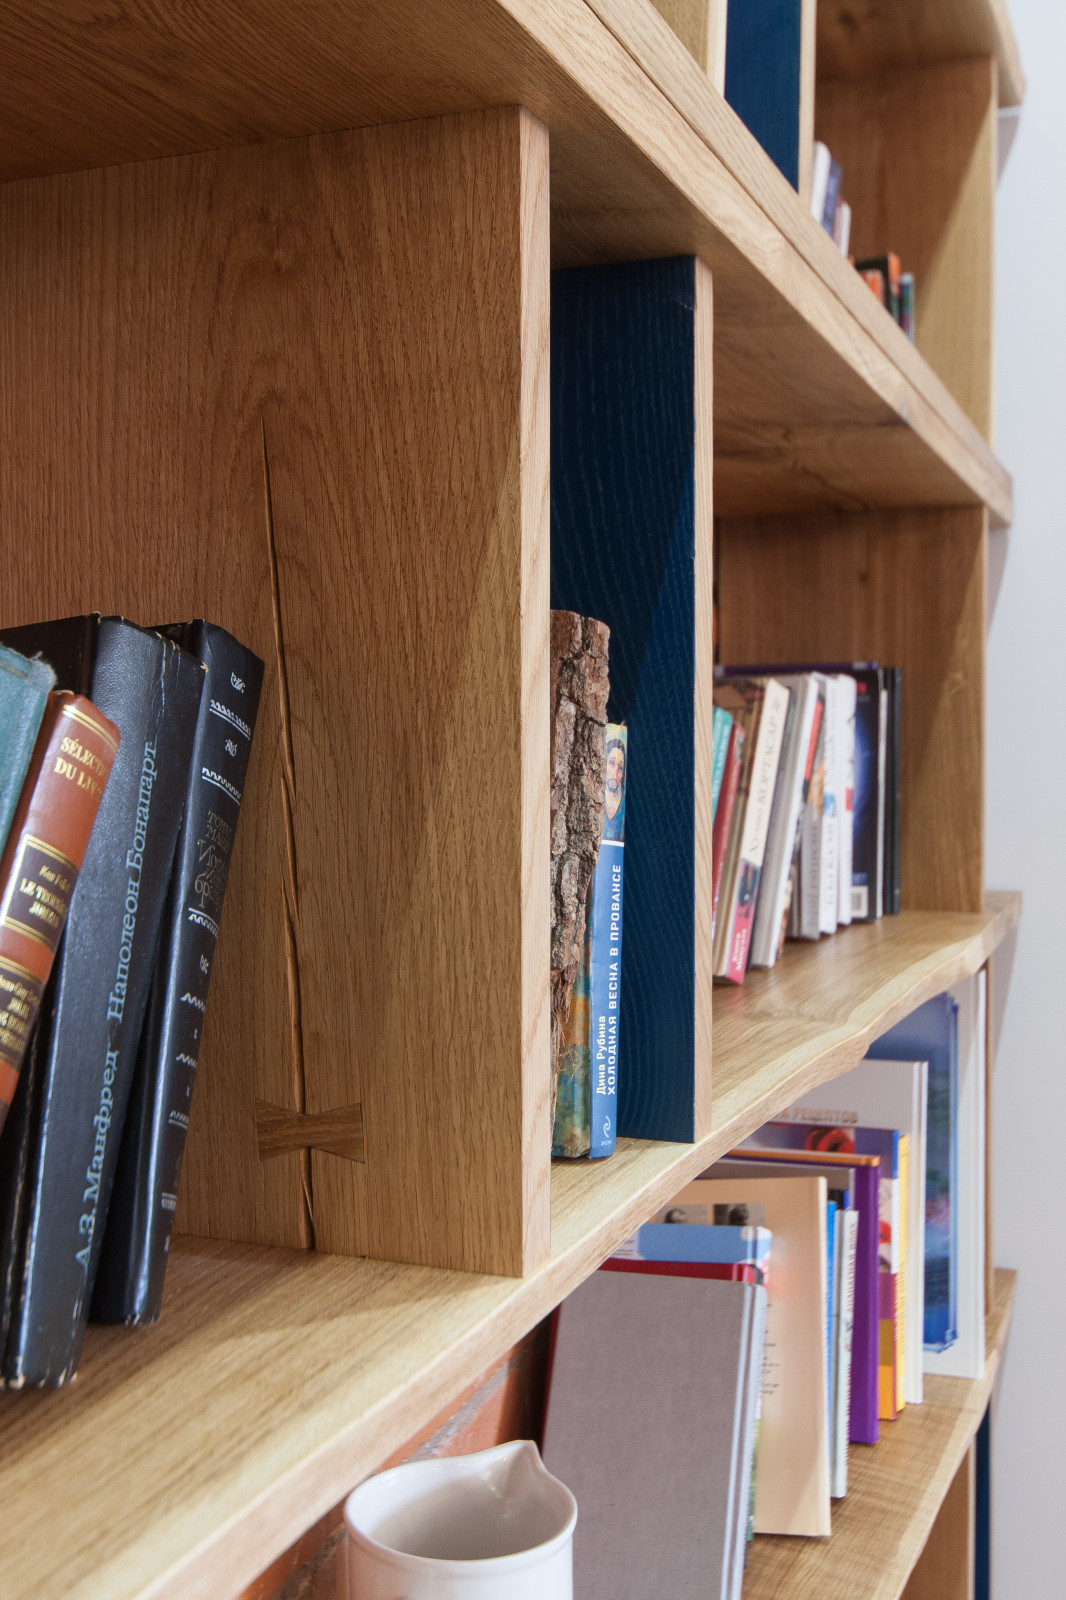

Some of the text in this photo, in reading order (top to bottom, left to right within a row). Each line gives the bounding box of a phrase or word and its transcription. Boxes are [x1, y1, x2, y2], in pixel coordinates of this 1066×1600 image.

[54, 756, 78, 781] DU
[83, 1051, 119, 1204] Манфред
[107, 877, 139, 1024] Наполеон
[125, 741, 157, 873] Бонапарт
[607, 864, 622, 1096] ХОЛОДНАЯ ВЕСНА В ПРОВАНСЕ
[596, 1015, 606, 1096] Дина Рубина
[792, 1107, 859, 1124] РЕЦЕПТОВ
